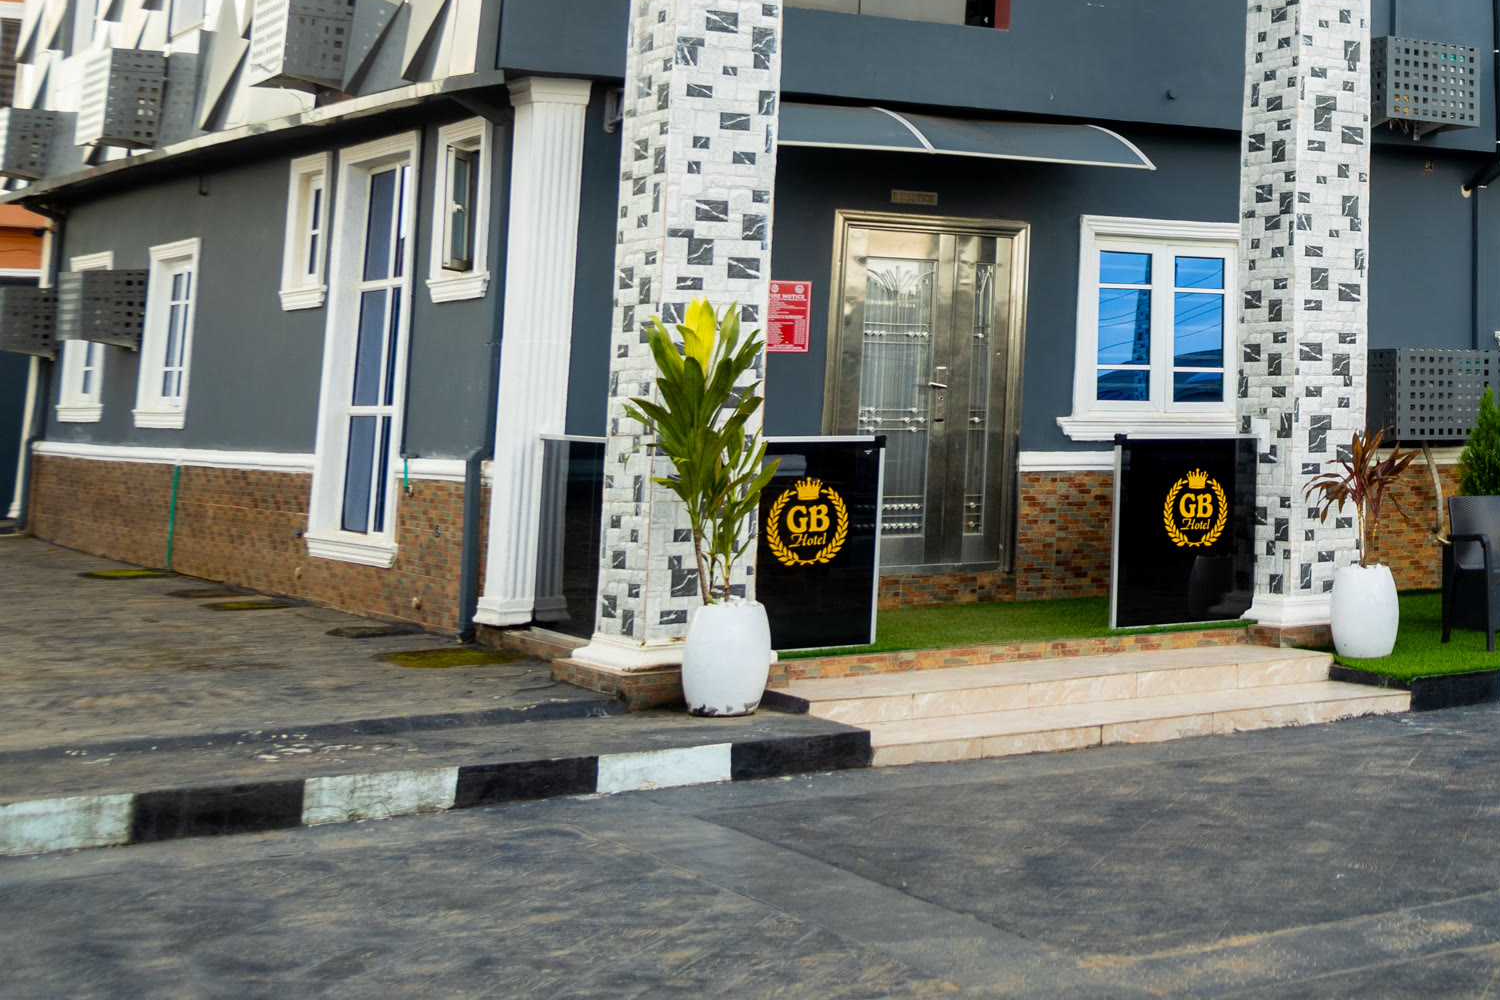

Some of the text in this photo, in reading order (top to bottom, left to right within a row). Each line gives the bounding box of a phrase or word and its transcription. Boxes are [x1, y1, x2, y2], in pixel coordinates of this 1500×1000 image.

[1179, 493, 1213, 518] GB
[786, 504, 830, 533] GB
[1180, 518, 1211, 530] Hotel
[788, 532, 827, 548] Hotel
